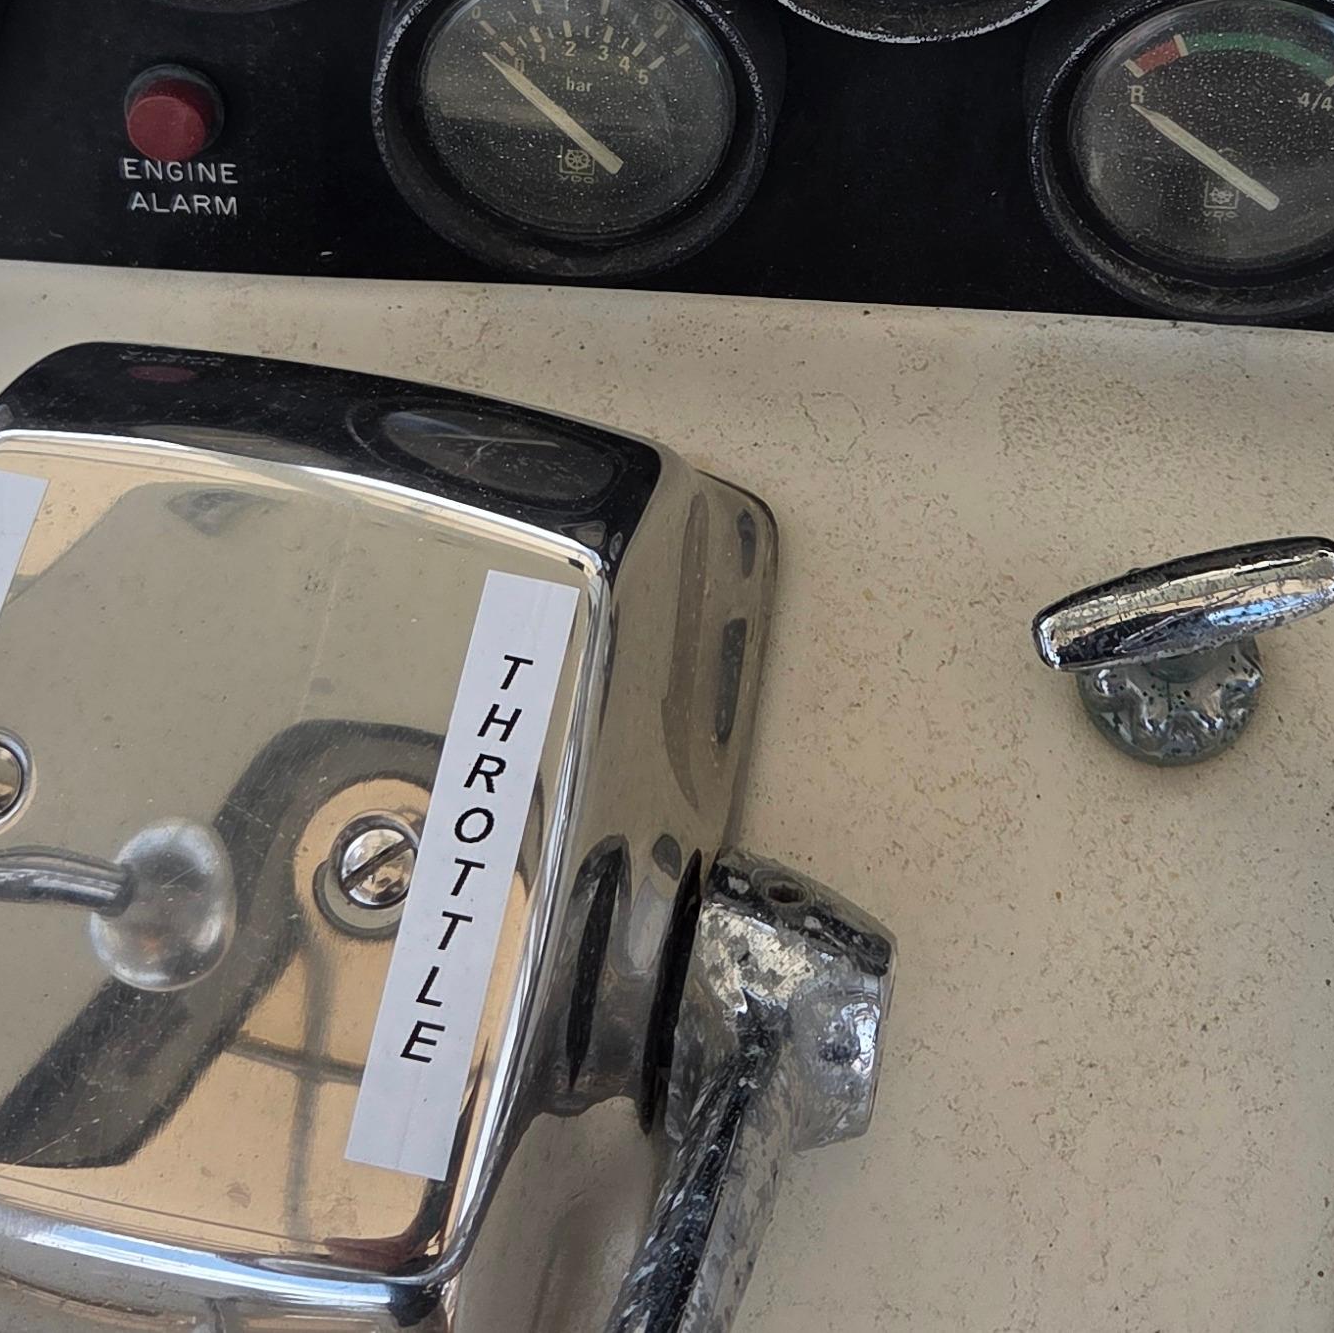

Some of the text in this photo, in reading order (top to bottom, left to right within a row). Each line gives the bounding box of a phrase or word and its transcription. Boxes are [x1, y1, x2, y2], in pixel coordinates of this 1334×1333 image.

[564, 41, 577, 57] 2
[597, 45, 609, 61] 3
[618, 56, 631, 73] 4
[637, 69, 649, 85] 5
[1129, 84, 1145, 104] R
[1297, 92, 1334, 112] 4/4
[123, 157, 239, 185] ENGINE
[130, 191, 238, 216] ALARM
[400, 654, 534, 1064] THROTTLE
